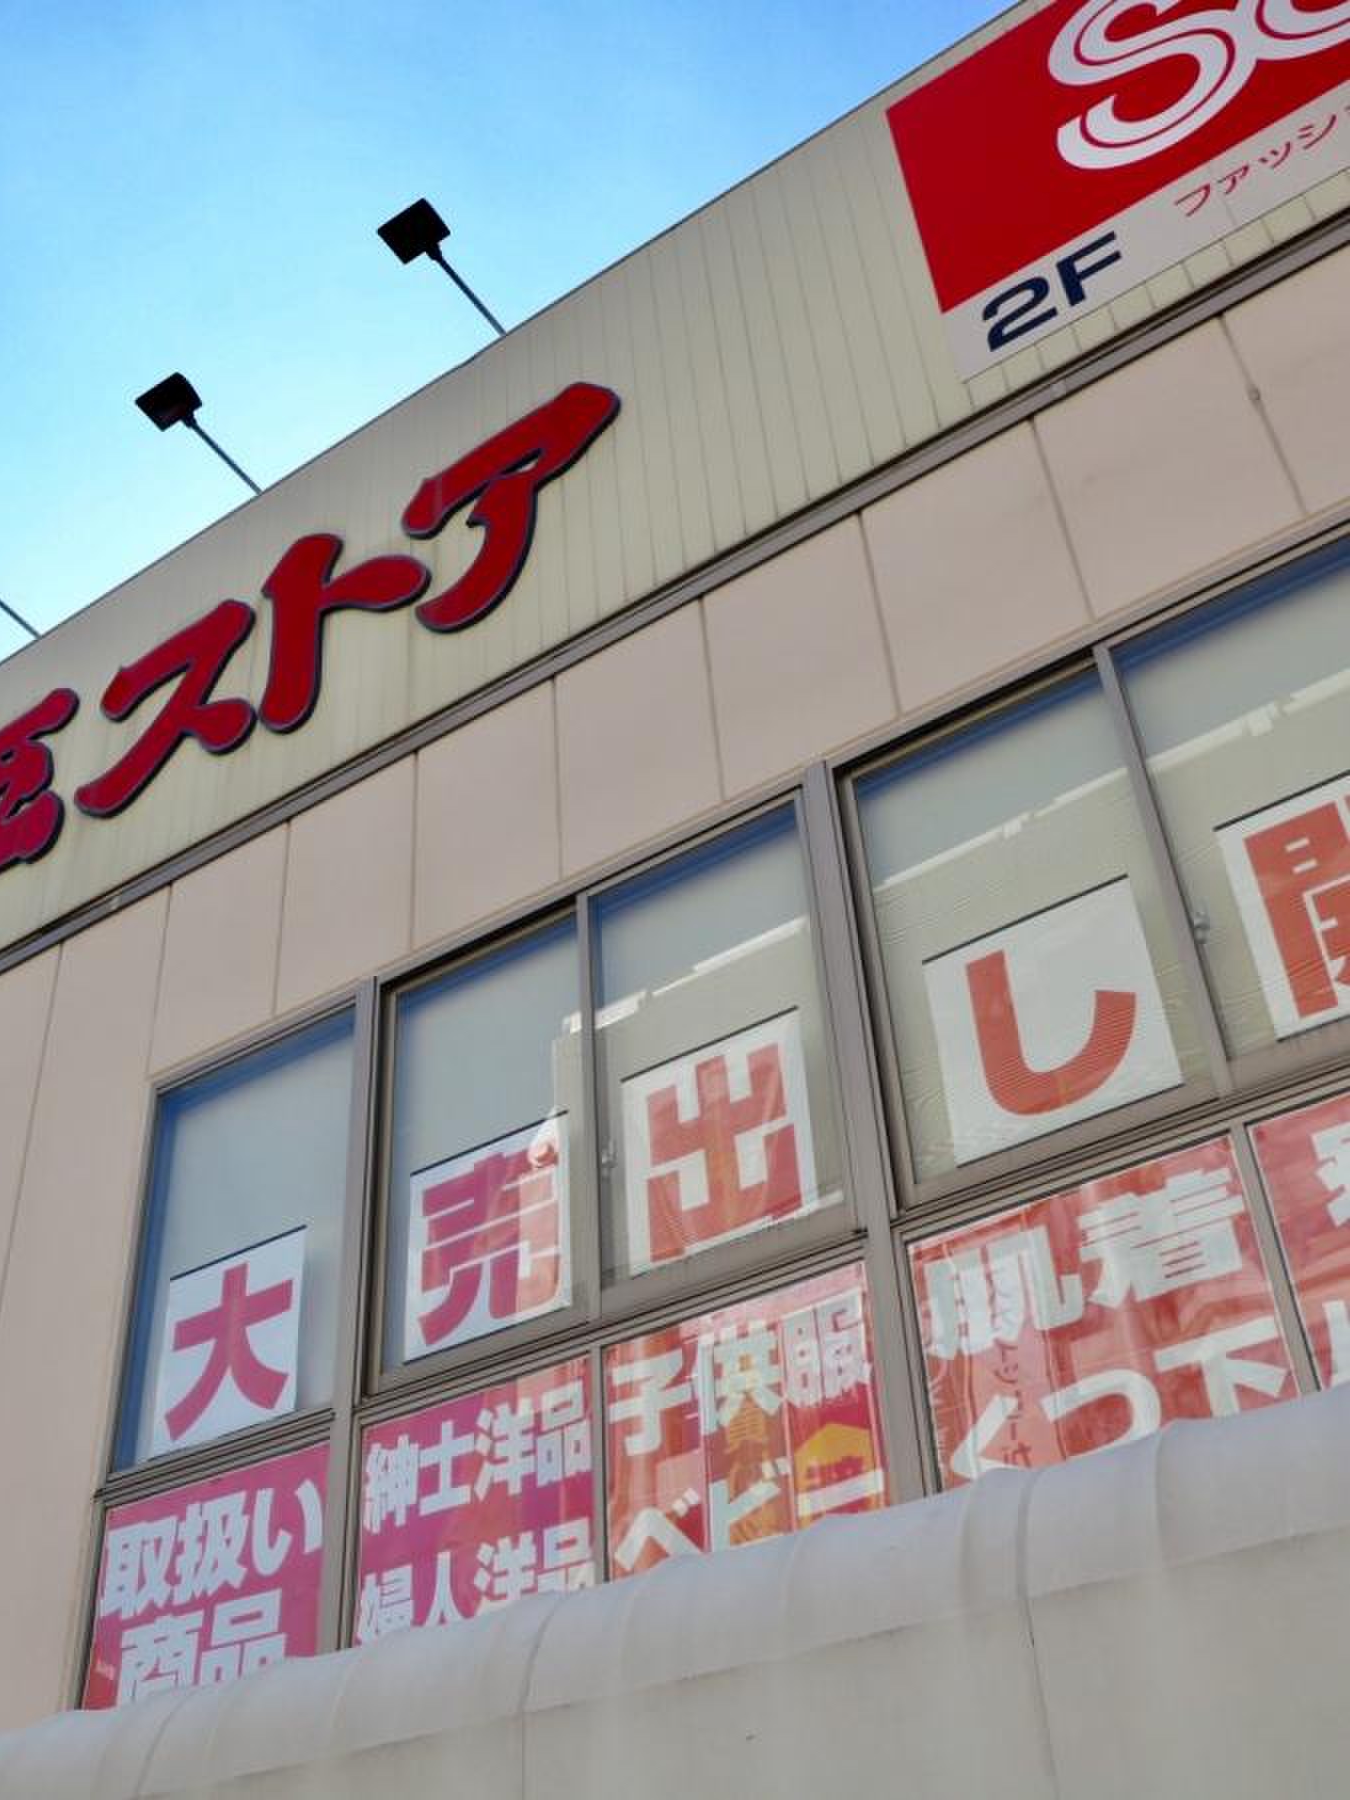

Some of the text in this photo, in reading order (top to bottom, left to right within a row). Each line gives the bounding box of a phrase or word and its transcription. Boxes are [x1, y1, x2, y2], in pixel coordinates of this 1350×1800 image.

[1174, 104, 1350, 217] ファッシ
[982, 231, 1122, 353] 2F
[923, 1166, 1246, 1360] 肌着
[604, 1291, 874, 1456] 子供服
[949, 1316, 1295, 1479] くつ下
[363, 1380, 593, 1535] 紳士洋品
[613, 1455, 887, 1572] ベビー
[100, 1480, 324, 1620] 取扱い
[356, 1518, 596, 1646] 婦人洋品
[117, 1588, 286, 1709] 商品
